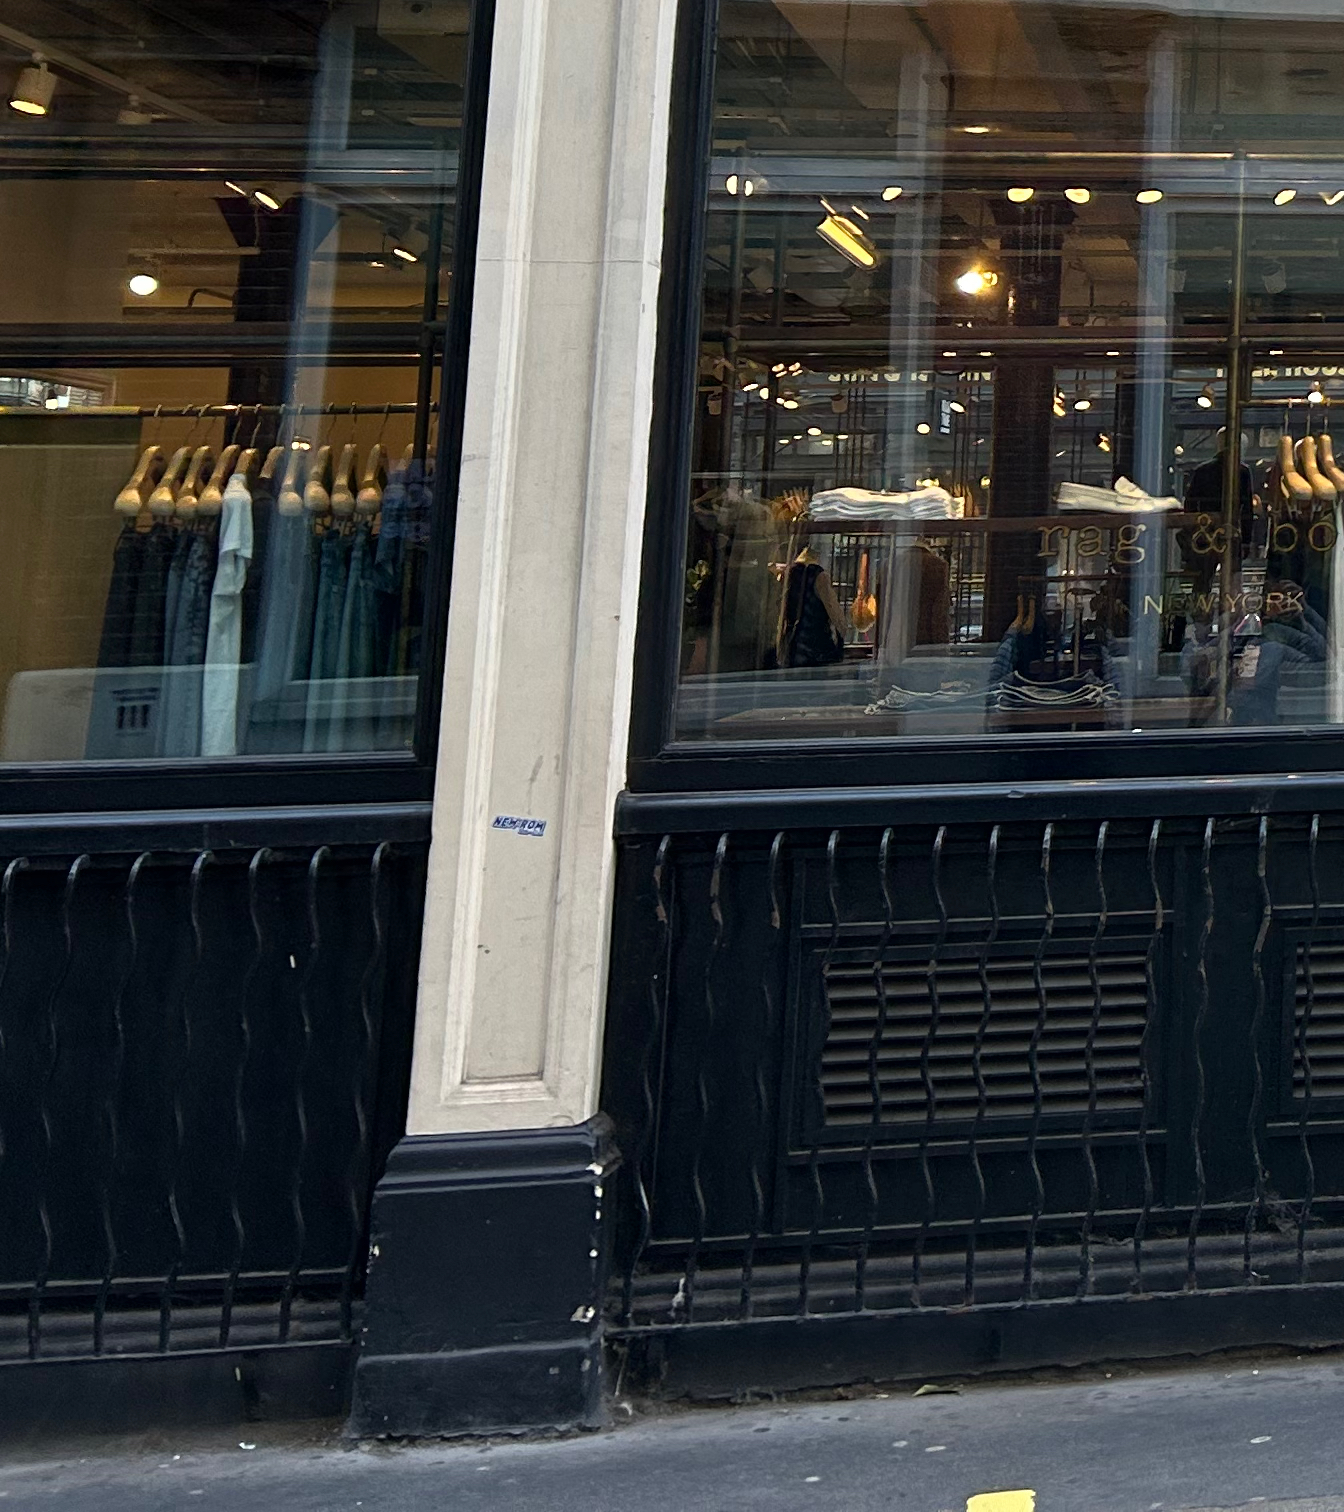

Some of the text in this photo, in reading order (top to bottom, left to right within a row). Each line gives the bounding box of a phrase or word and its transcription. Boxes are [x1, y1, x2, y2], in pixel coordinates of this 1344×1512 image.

[1036, 522, 1147, 565] rag
[1191, 513, 1228, 555] &
[1143, 591, 1305, 615] NEW YORK
